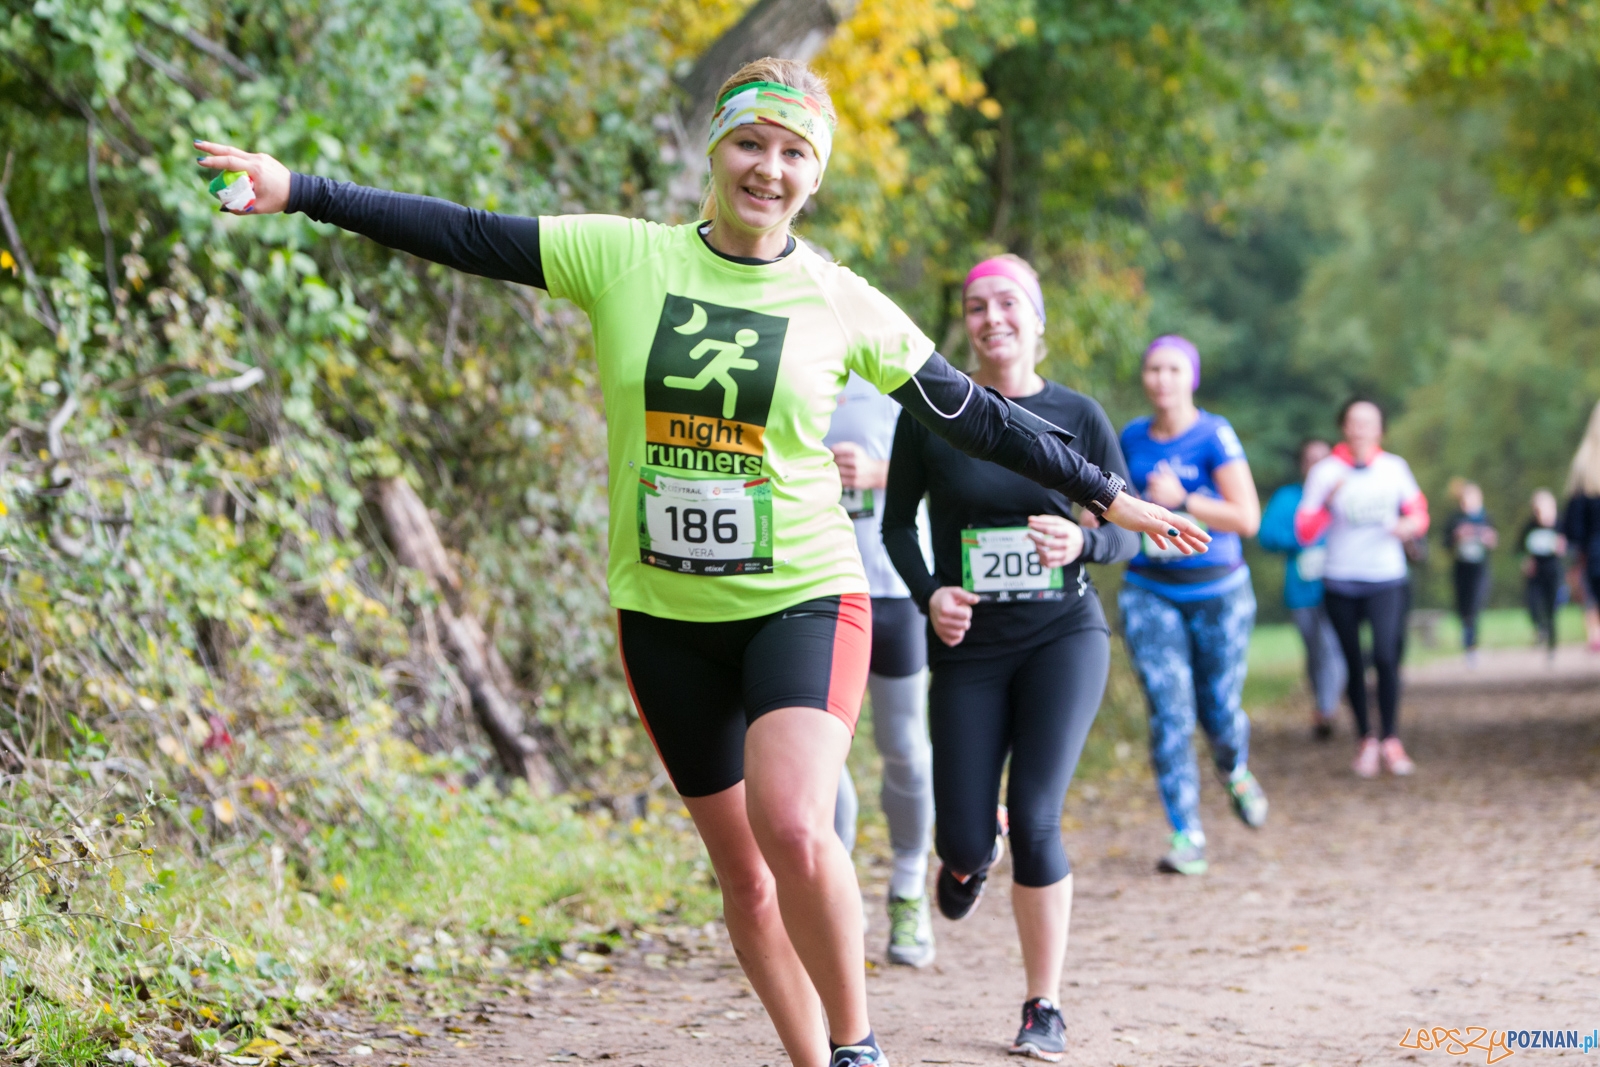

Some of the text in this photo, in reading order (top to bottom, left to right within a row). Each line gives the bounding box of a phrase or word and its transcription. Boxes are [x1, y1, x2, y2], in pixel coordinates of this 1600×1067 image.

[670, 415, 744, 447] night
[647, 444, 761, 475] runners
[665, 506, 738, 544] 186
[688, 547, 715, 557] VERA
[982, 552, 1042, 578] 208
